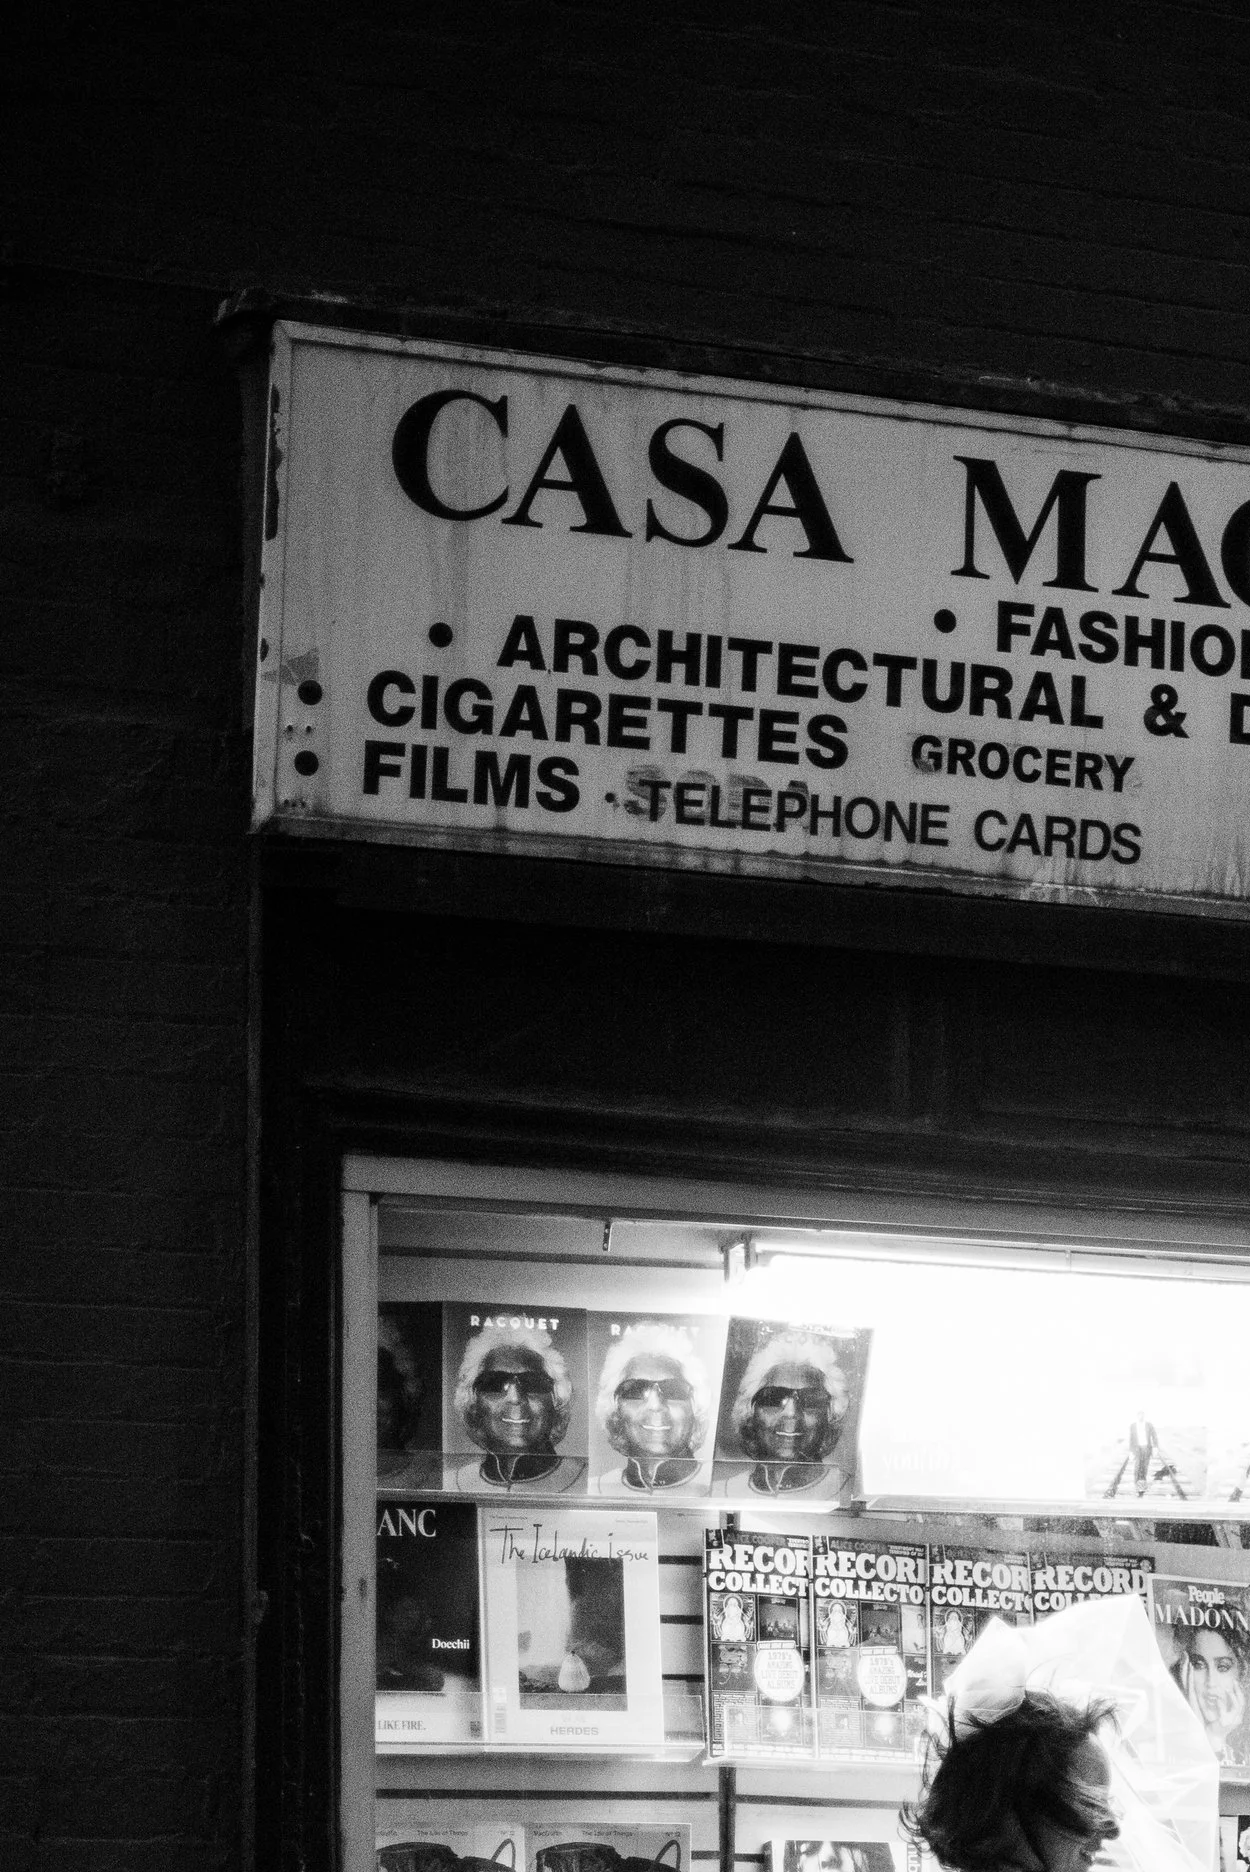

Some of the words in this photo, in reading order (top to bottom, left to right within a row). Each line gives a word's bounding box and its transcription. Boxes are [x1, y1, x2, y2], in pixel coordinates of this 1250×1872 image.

[391, 388, 855, 565] CASA
[497, 614, 1104, 728] ARCHITECTURAL
[1144, 684, 1189, 738] &
[365, 669, 850, 770] CIGARETTES
[362, 739, 581, 813] FILMS
[911, 733, 1136, 794] GROCERY
[637, 779, 951, 848] TELEPHONE
[973, 809, 1143, 866] CARDS
[470, 1314, 560, 1331] RACQUET
[488, 1524, 525, 1565] The
[531, 1523, 599, 1564] Icelandic
[1033, 1564, 1148, 1595] RECORD
[1188, 1585, 1226, 1608] People
[430, 1637, 472, 1651] Doechii
[377, 1719, 400, 1731] LIKE
[401, 1720, 427, 1732] FIRE.
